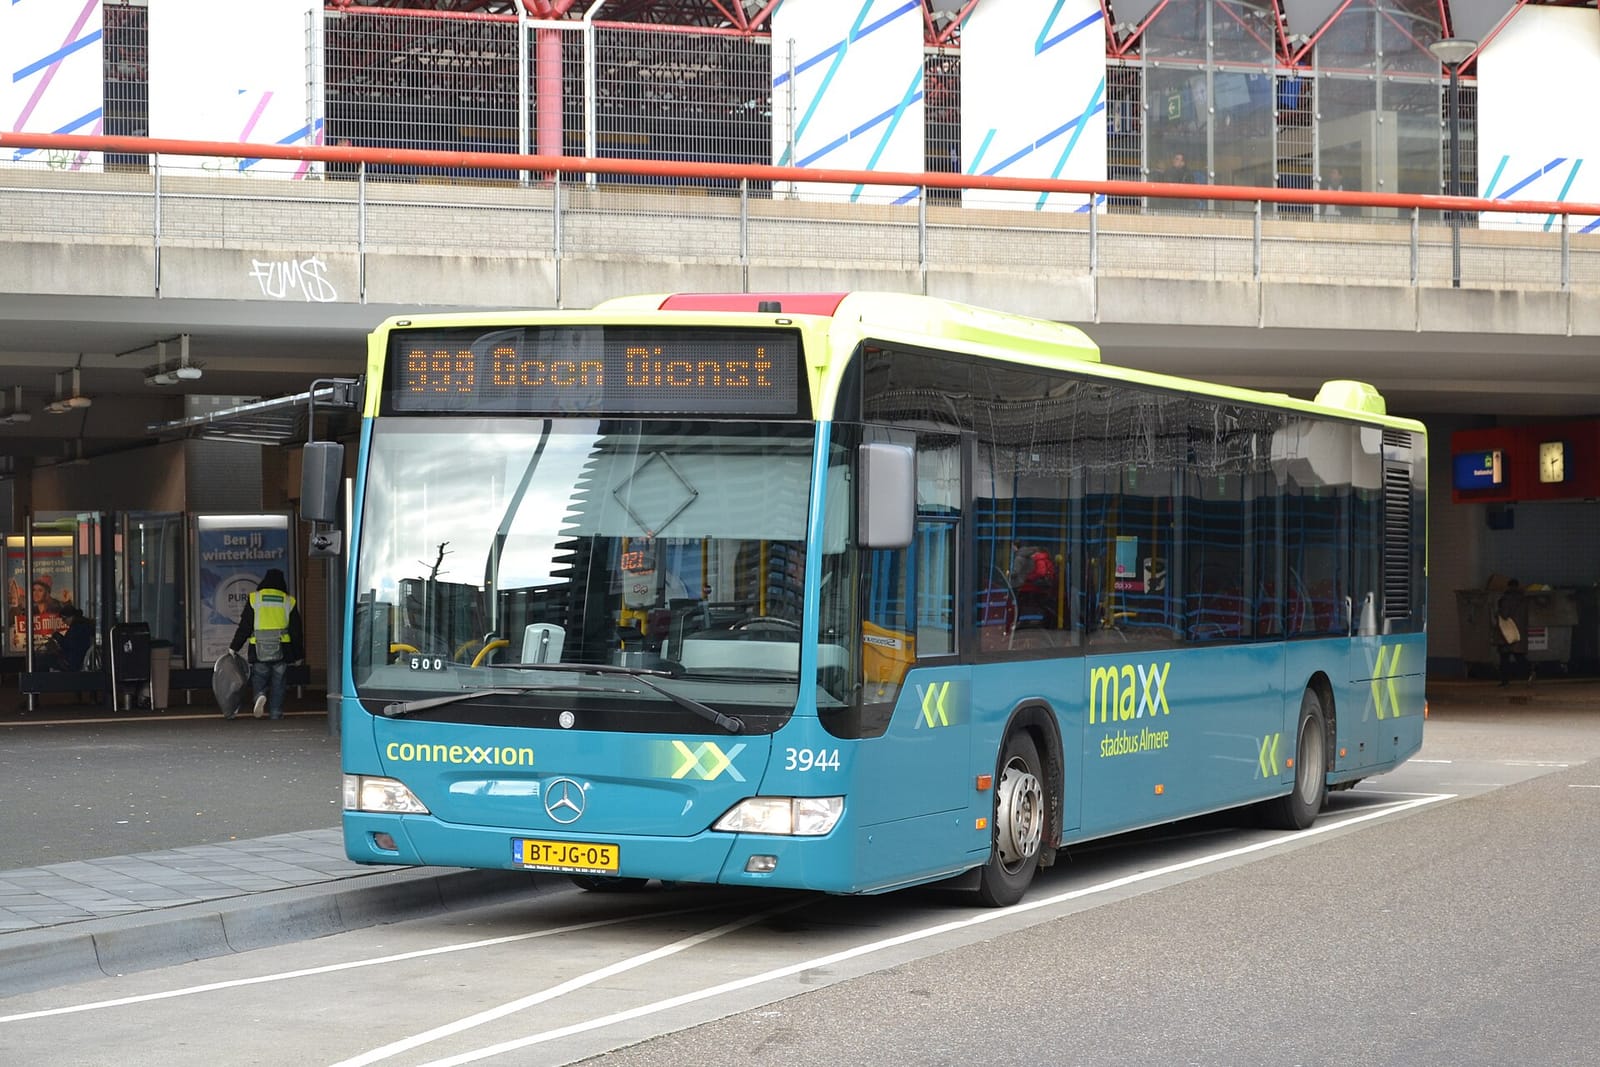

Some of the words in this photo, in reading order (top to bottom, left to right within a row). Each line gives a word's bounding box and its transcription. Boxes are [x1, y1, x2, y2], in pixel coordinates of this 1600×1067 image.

[408, 350, 474, 392] 999
[223, 534, 247, 546] Ben
[249, 532, 263, 548] jij
[202, 547, 284, 561] winterklaar?
[228, 593, 249, 603] PUR
[410, 657, 443, 671] 500
[1089, 662, 1171, 725] maxx
[385, 741, 534, 766] connexxion
[1100, 729, 1139, 758] stadsbus
[1139, 726, 1169, 751] Almere
[785, 747, 841, 772] 3944
[530, 844, 611, 866] BT-JG-05
